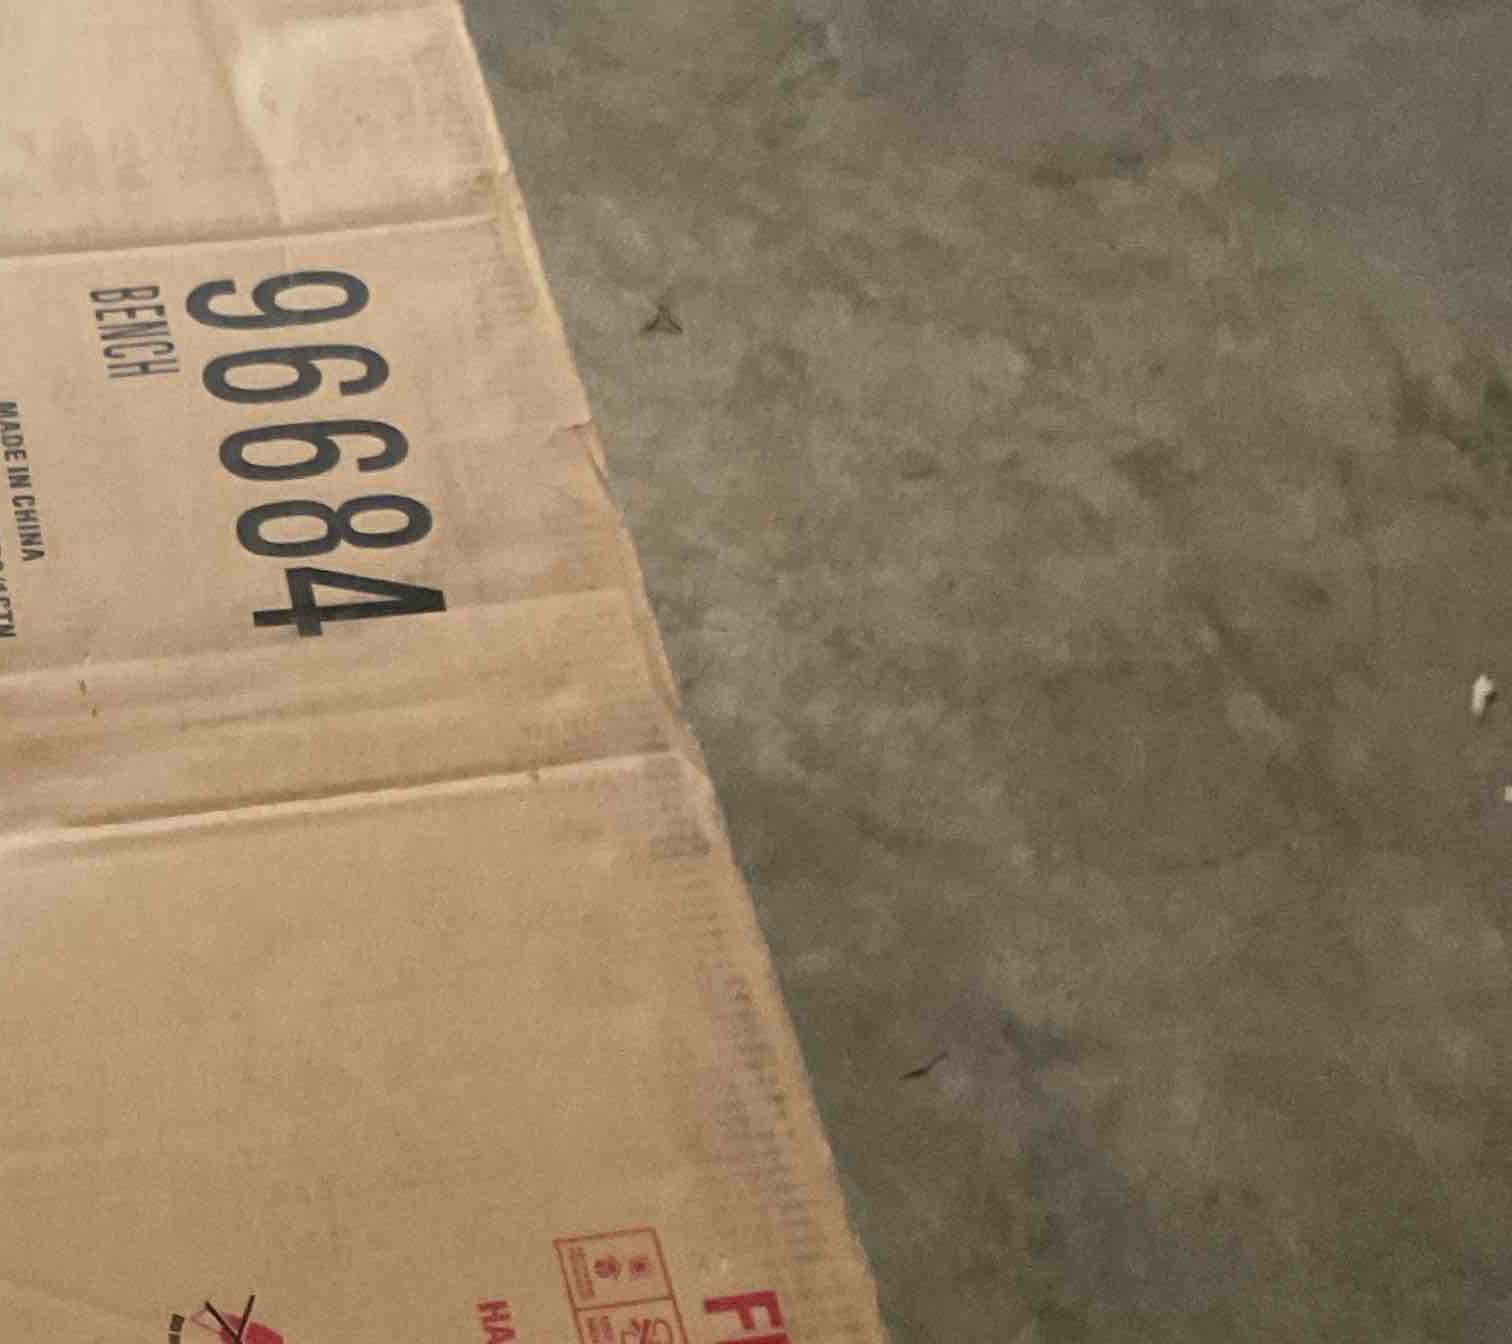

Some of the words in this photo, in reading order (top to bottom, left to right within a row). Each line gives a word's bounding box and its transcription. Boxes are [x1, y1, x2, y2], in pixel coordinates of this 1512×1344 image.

[90, 284, 179, 379] BENCH
[8, 466, 31, 488] IN
[185, 268, 446, 638] 96684
[11, 495, 45, 561] CHINA
